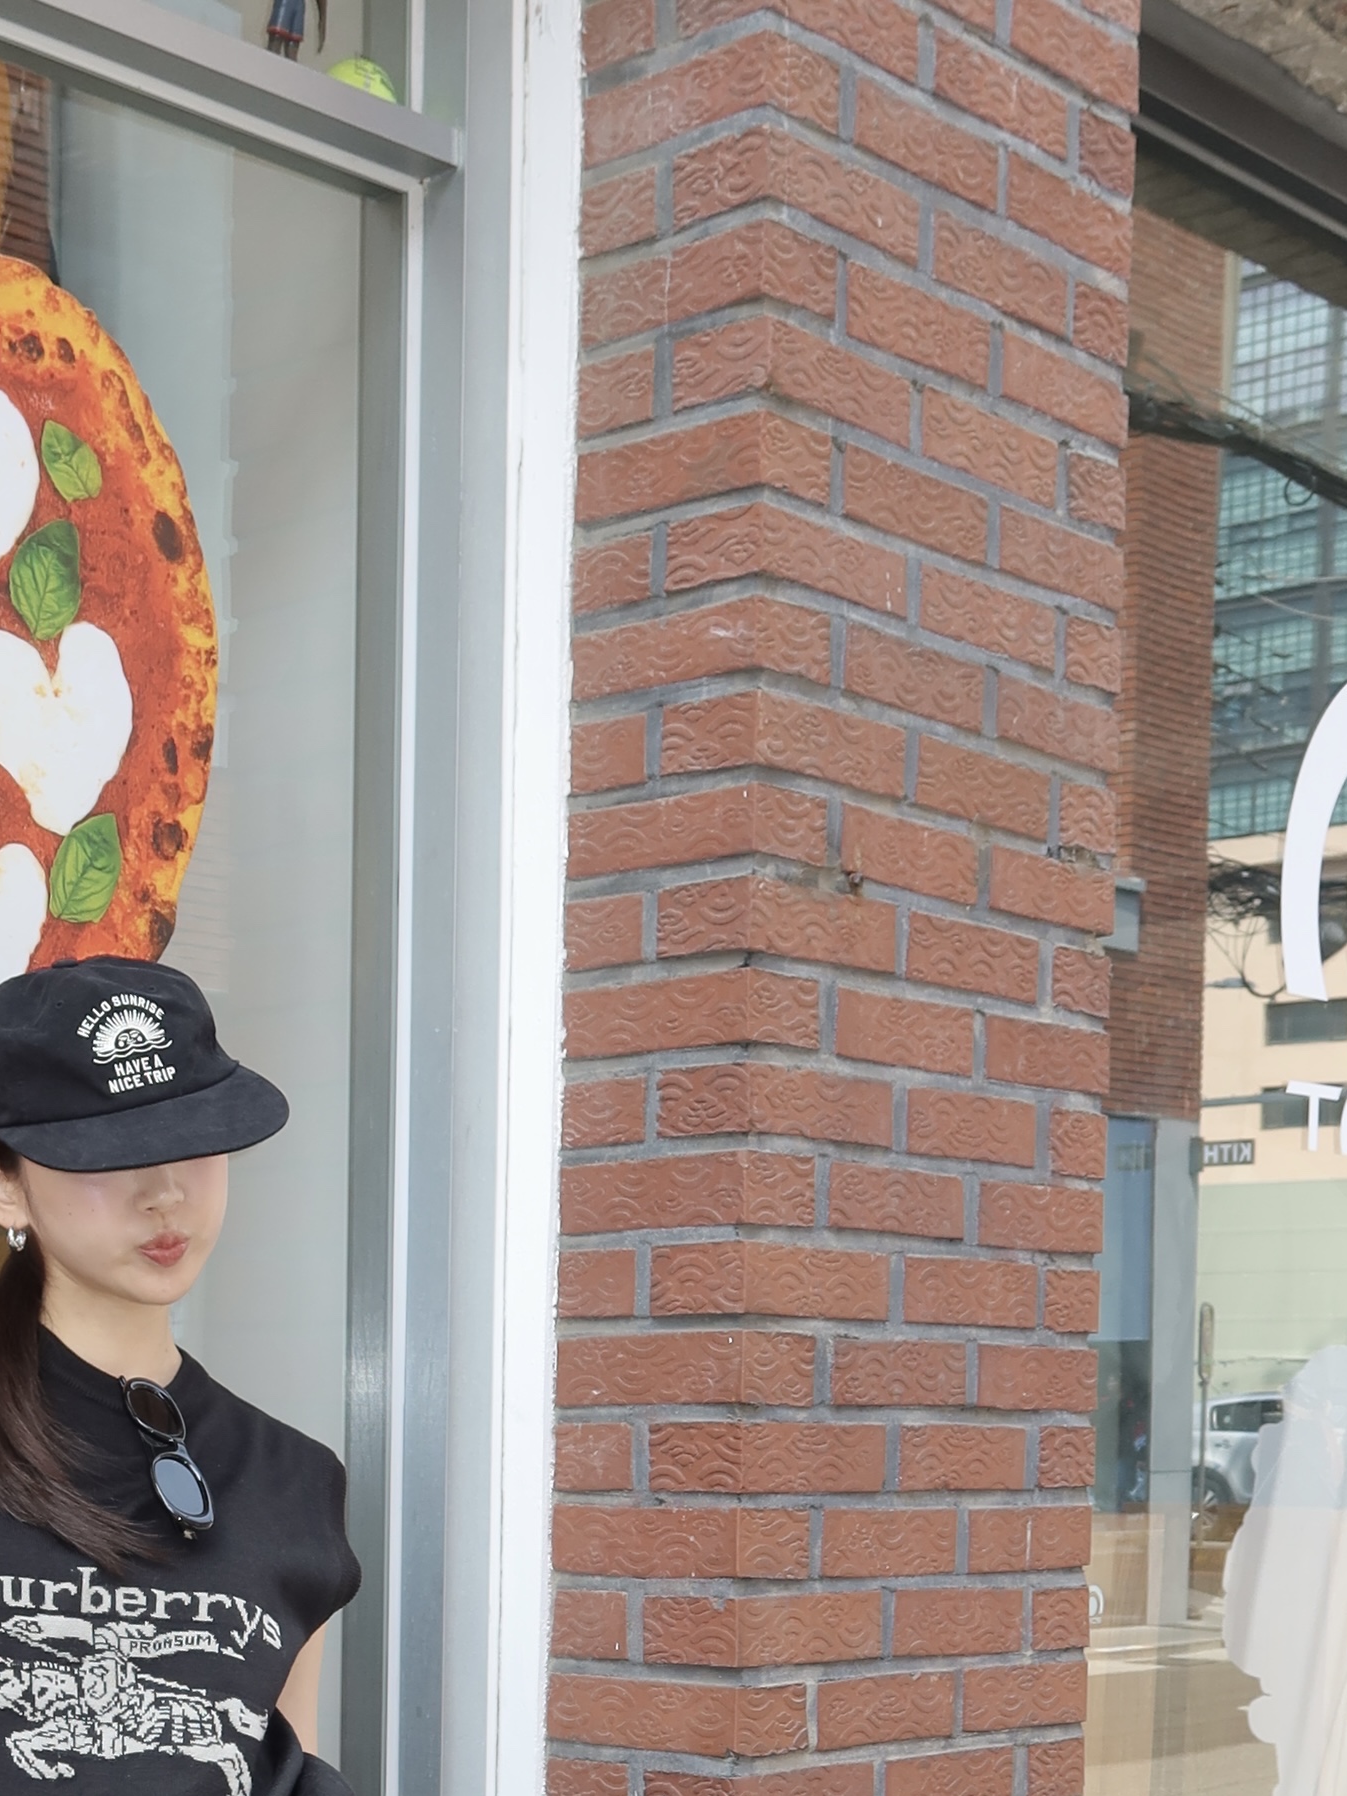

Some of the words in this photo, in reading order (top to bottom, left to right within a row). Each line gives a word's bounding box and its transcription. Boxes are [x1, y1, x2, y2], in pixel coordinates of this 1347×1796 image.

[77, 1001, 112, 1038] HELLO
[111, 993, 165, 1021] SUNRISE
[113, 1056, 153, 1077] HAVE
[153, 1054, 163, 1068] A
[107, 1073, 145, 1094] NICE
[143, 1066, 177, 1085] TRIP
